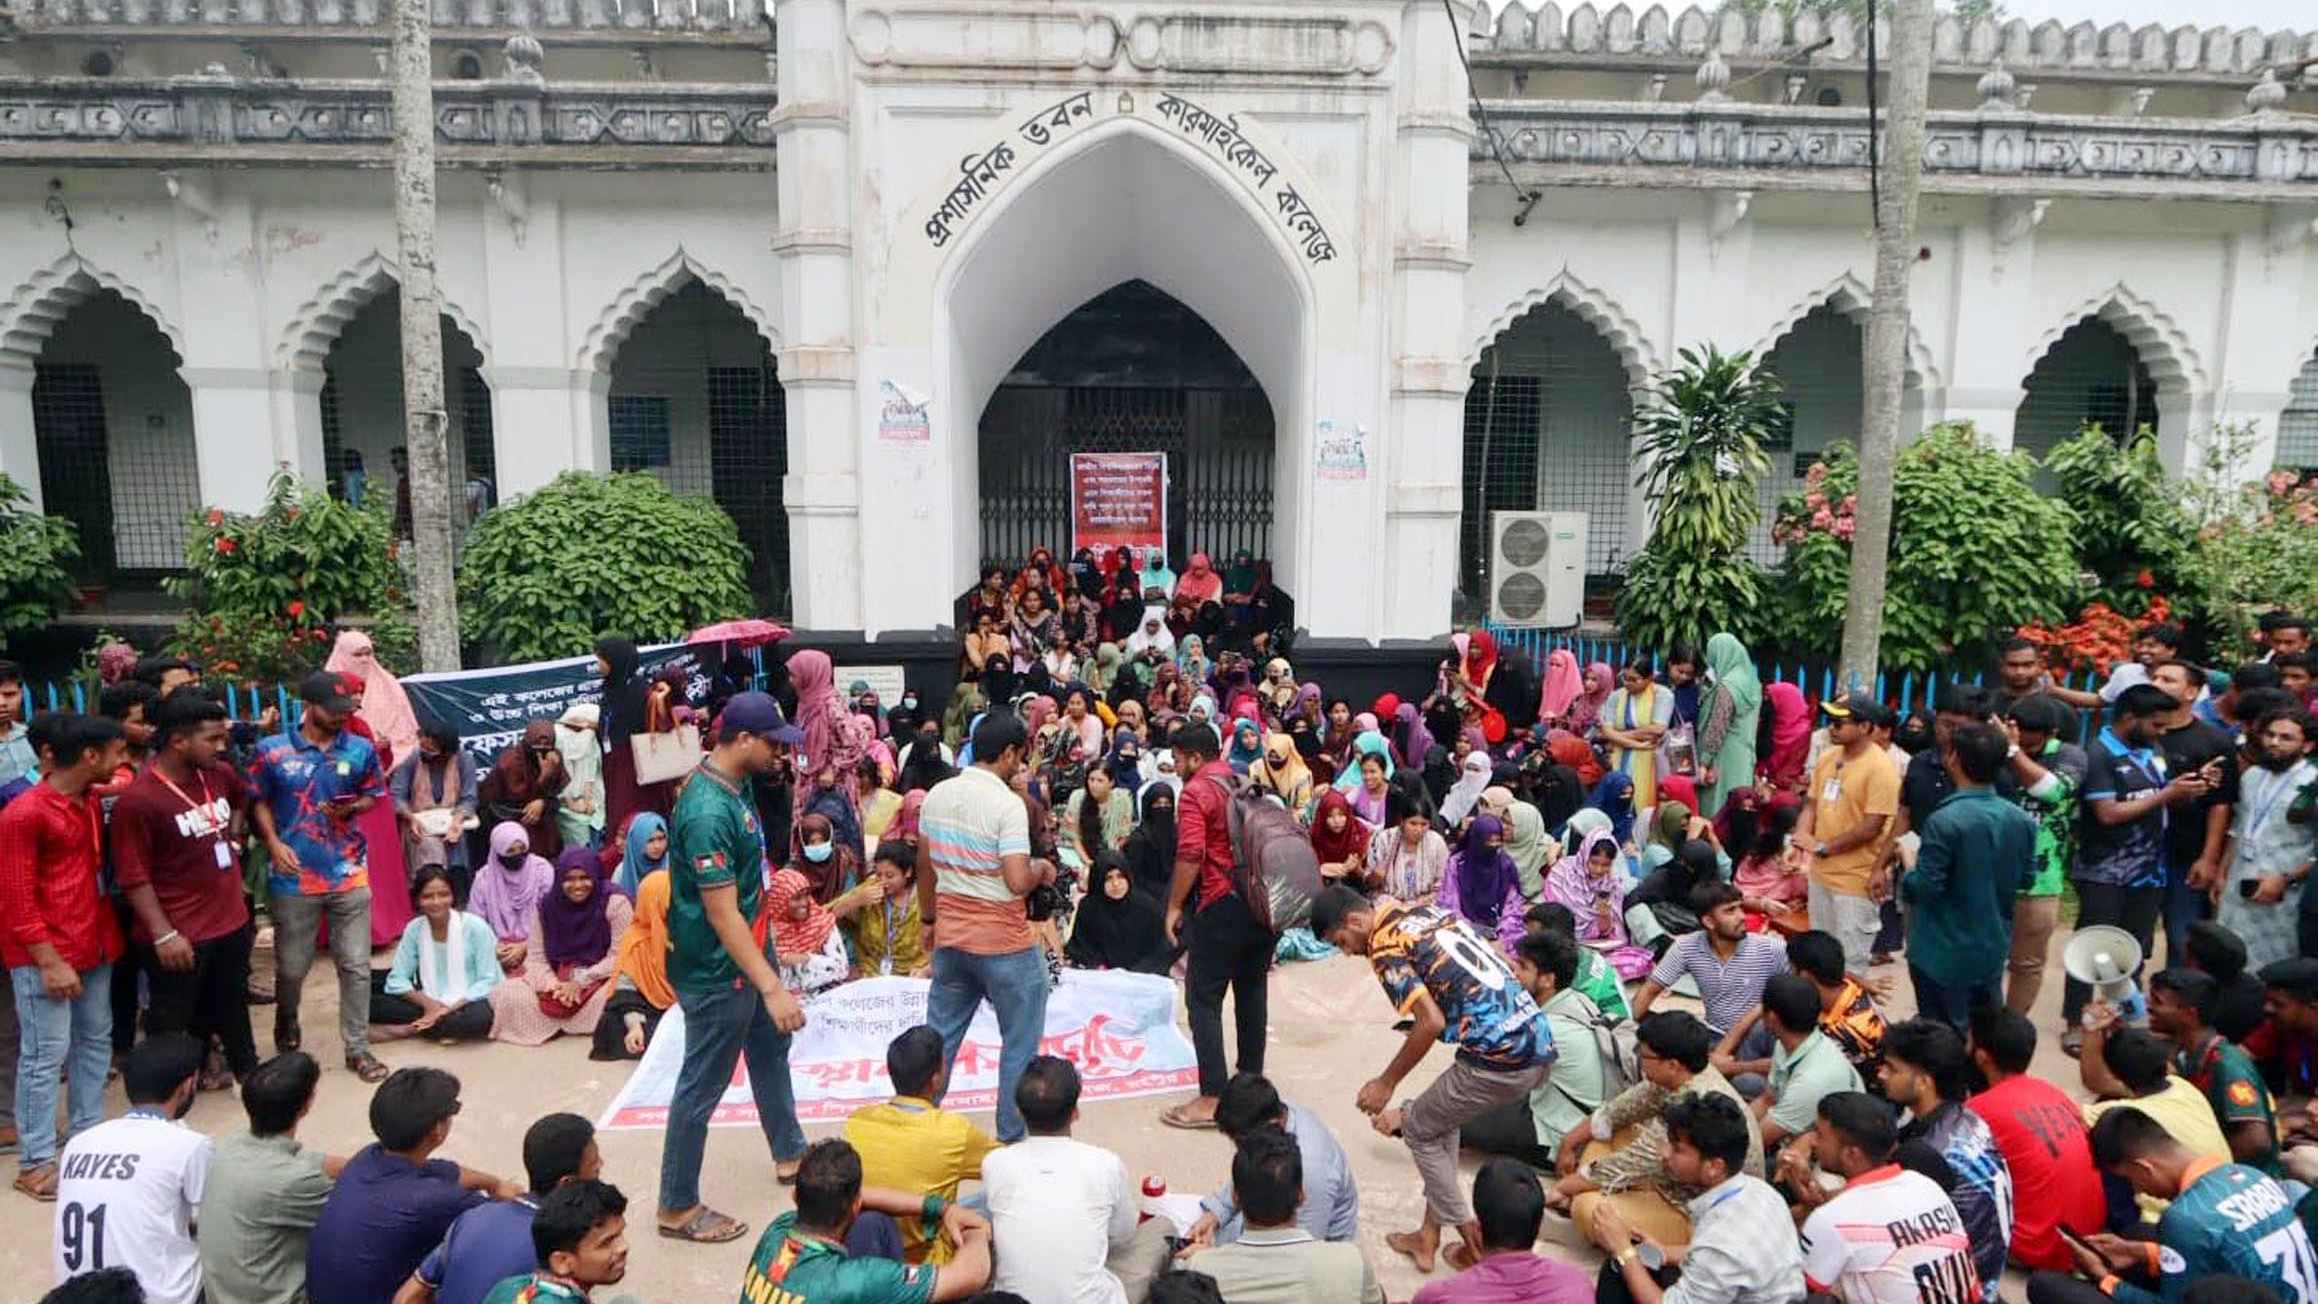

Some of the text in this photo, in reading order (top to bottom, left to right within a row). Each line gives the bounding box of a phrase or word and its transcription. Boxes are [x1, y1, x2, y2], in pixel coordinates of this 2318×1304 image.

[926, 92, 1093, 248] প্রশাসনিক ভবন
[1155, 92, 1338, 265] কারমাইকেল কলেজ
[63, 1153, 141, 1180] KAYES
[62, 1201, 107, 1271] 91
